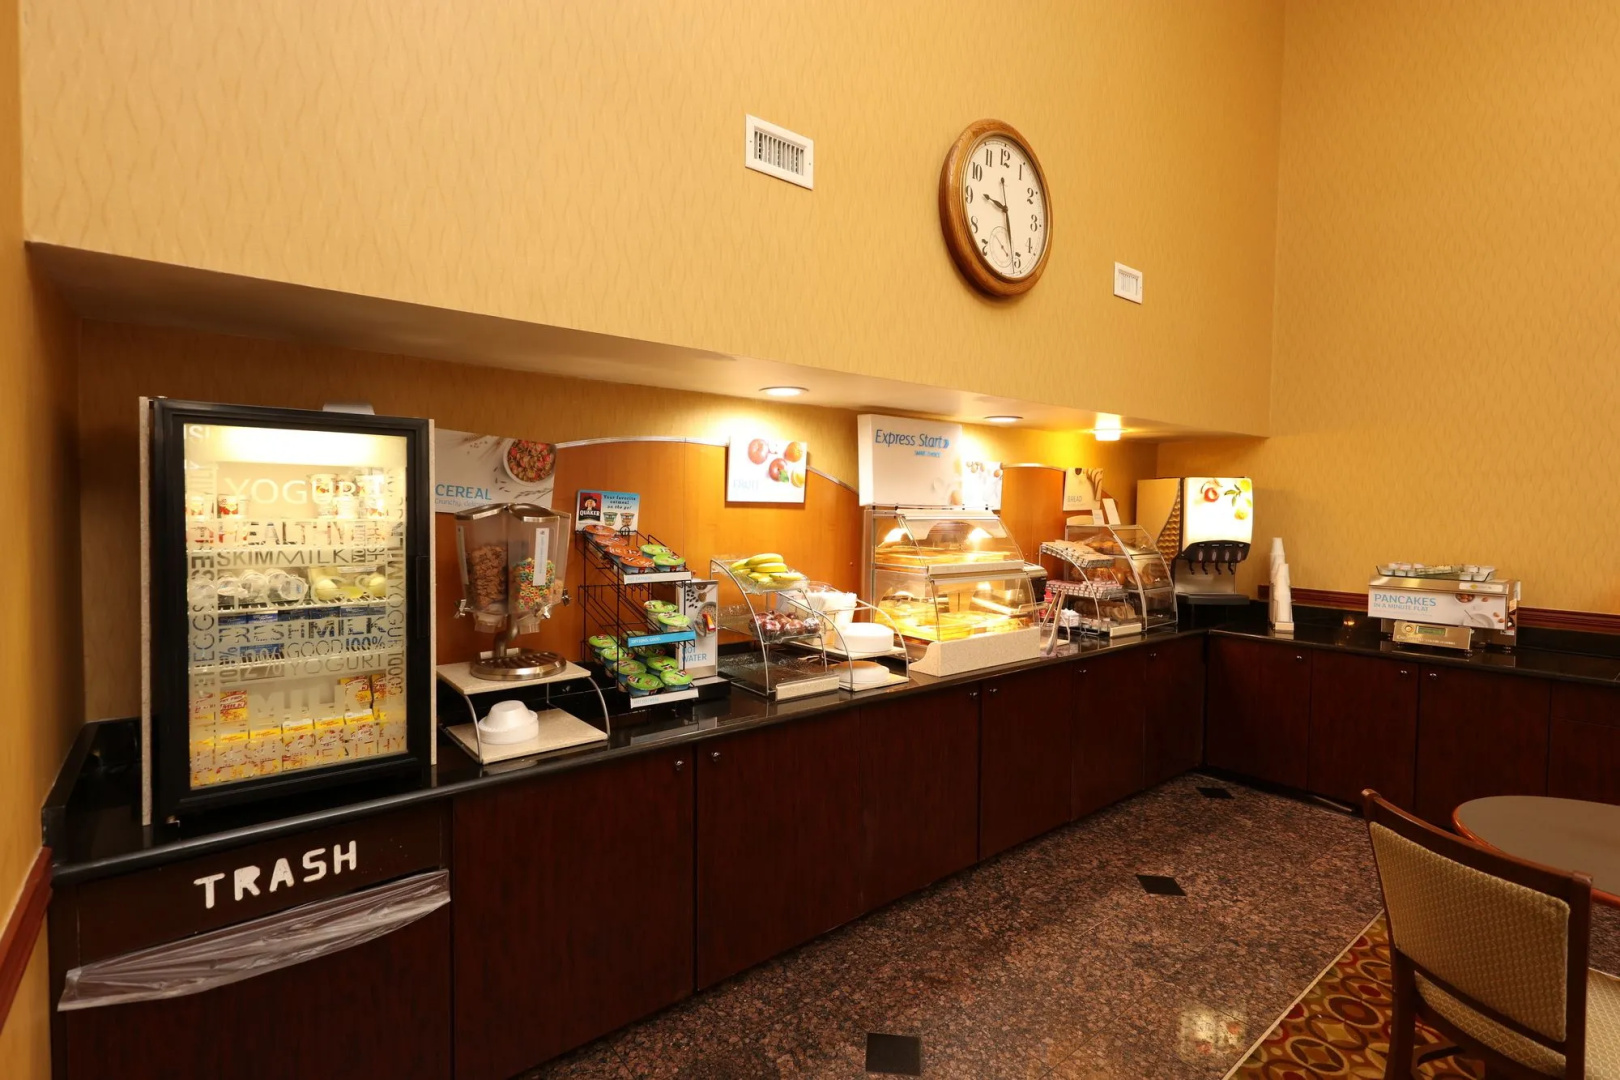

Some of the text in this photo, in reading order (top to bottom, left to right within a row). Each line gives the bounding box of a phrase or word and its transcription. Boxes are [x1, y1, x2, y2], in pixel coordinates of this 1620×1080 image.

[986, 148, 992, 167] 11
[1000, 148, 1010, 168] 12
[972, 162, 982, 182] 10
[1018, 164, 1022, 180] 1
[966, 184, 973, 204] 9
[1027, 188, 1034, 204] 2
[970, 216, 978, 234] 8
[1030, 214, 1038, 232] 3
[982, 238, 988, 256] 7
[1025, 237, 1032, 254] 4
[1014, 252, 1021, 268] 5
[875, 429, 942, 448] Express Start
[435, 484, 492, 500] CEREAL
[1374, 593, 1437, 606] PANCAKES
[286, 636, 386, 659] GOOD 100%
[290, 654, 381, 676] YOGURT
[683, 653, 707, 662] WATER
[192, 840, 358, 910] TRASH
